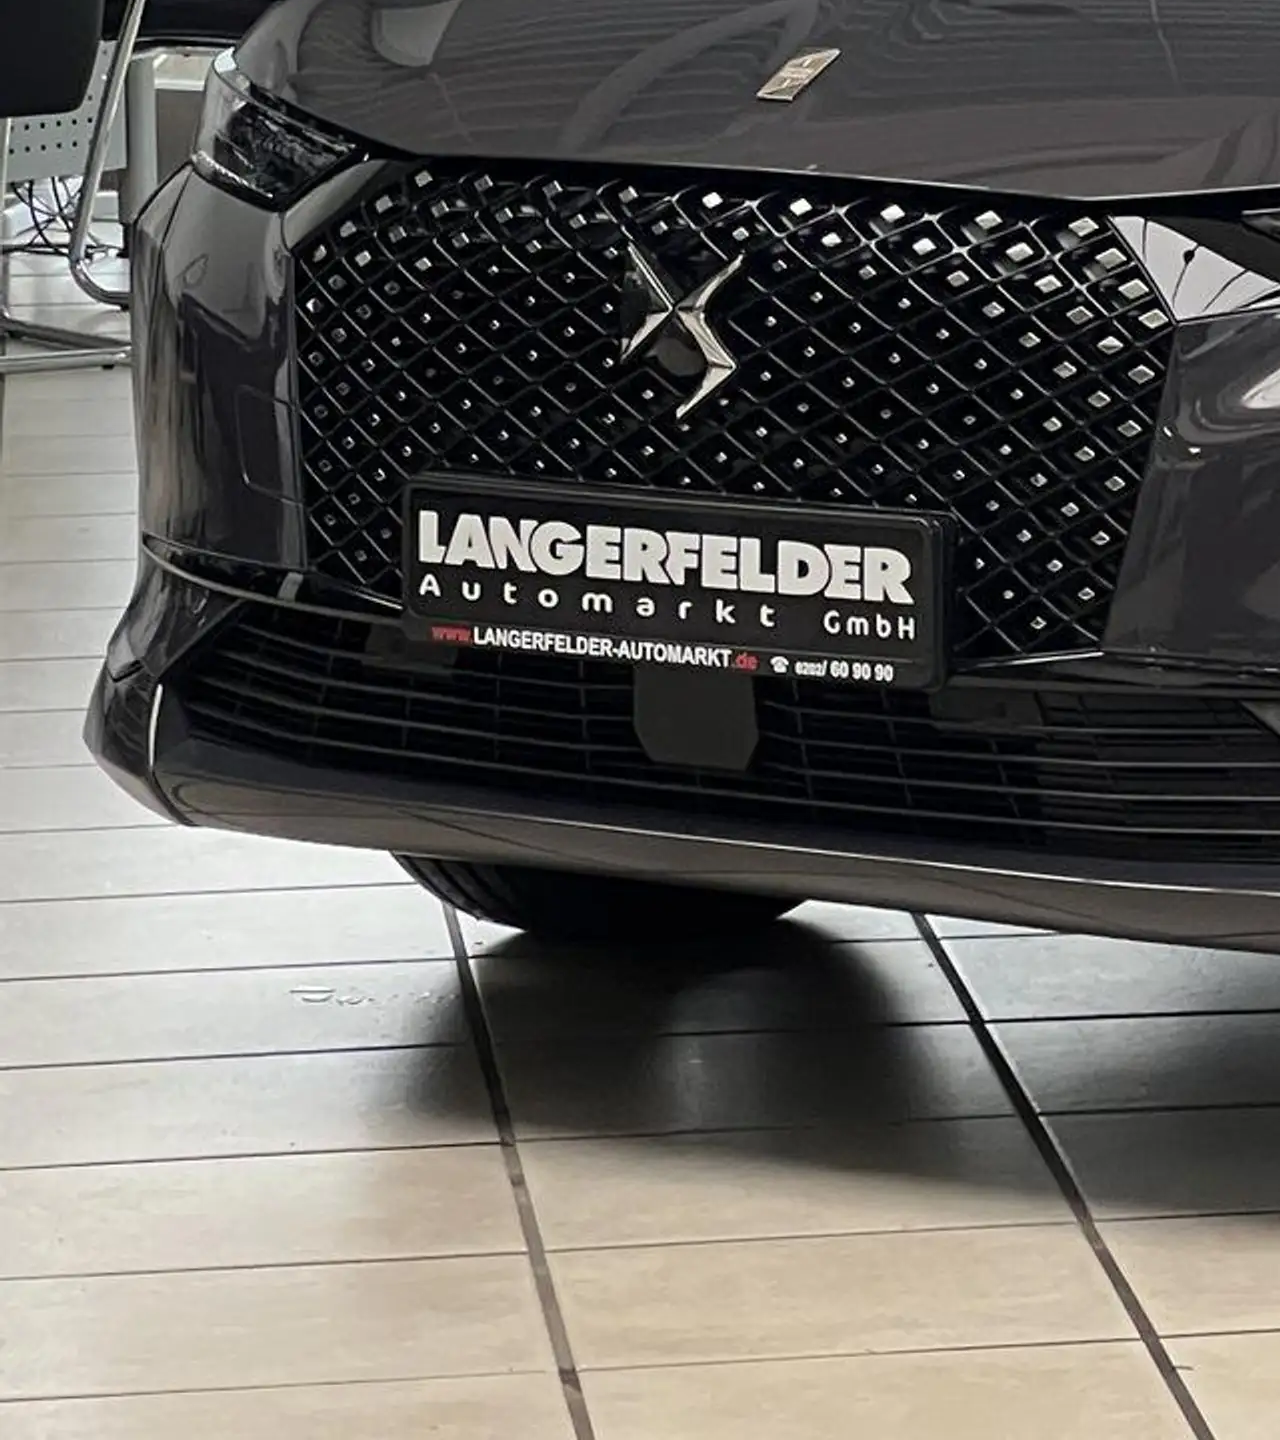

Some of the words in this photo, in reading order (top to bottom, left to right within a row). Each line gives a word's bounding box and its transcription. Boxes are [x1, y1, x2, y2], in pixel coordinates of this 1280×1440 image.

[418, 510, 915, 605] LANGERFELDER
[419, 573, 777, 628] Automarkt
[823, 610, 917, 641] GmbH
[431, 624, 758, 672] www.LANGERFELDER-AUTOMARKT.de
[830, 660, 849, 678] 60
[852, 662, 871, 680] 90
[874, 664, 893, 682] 90
